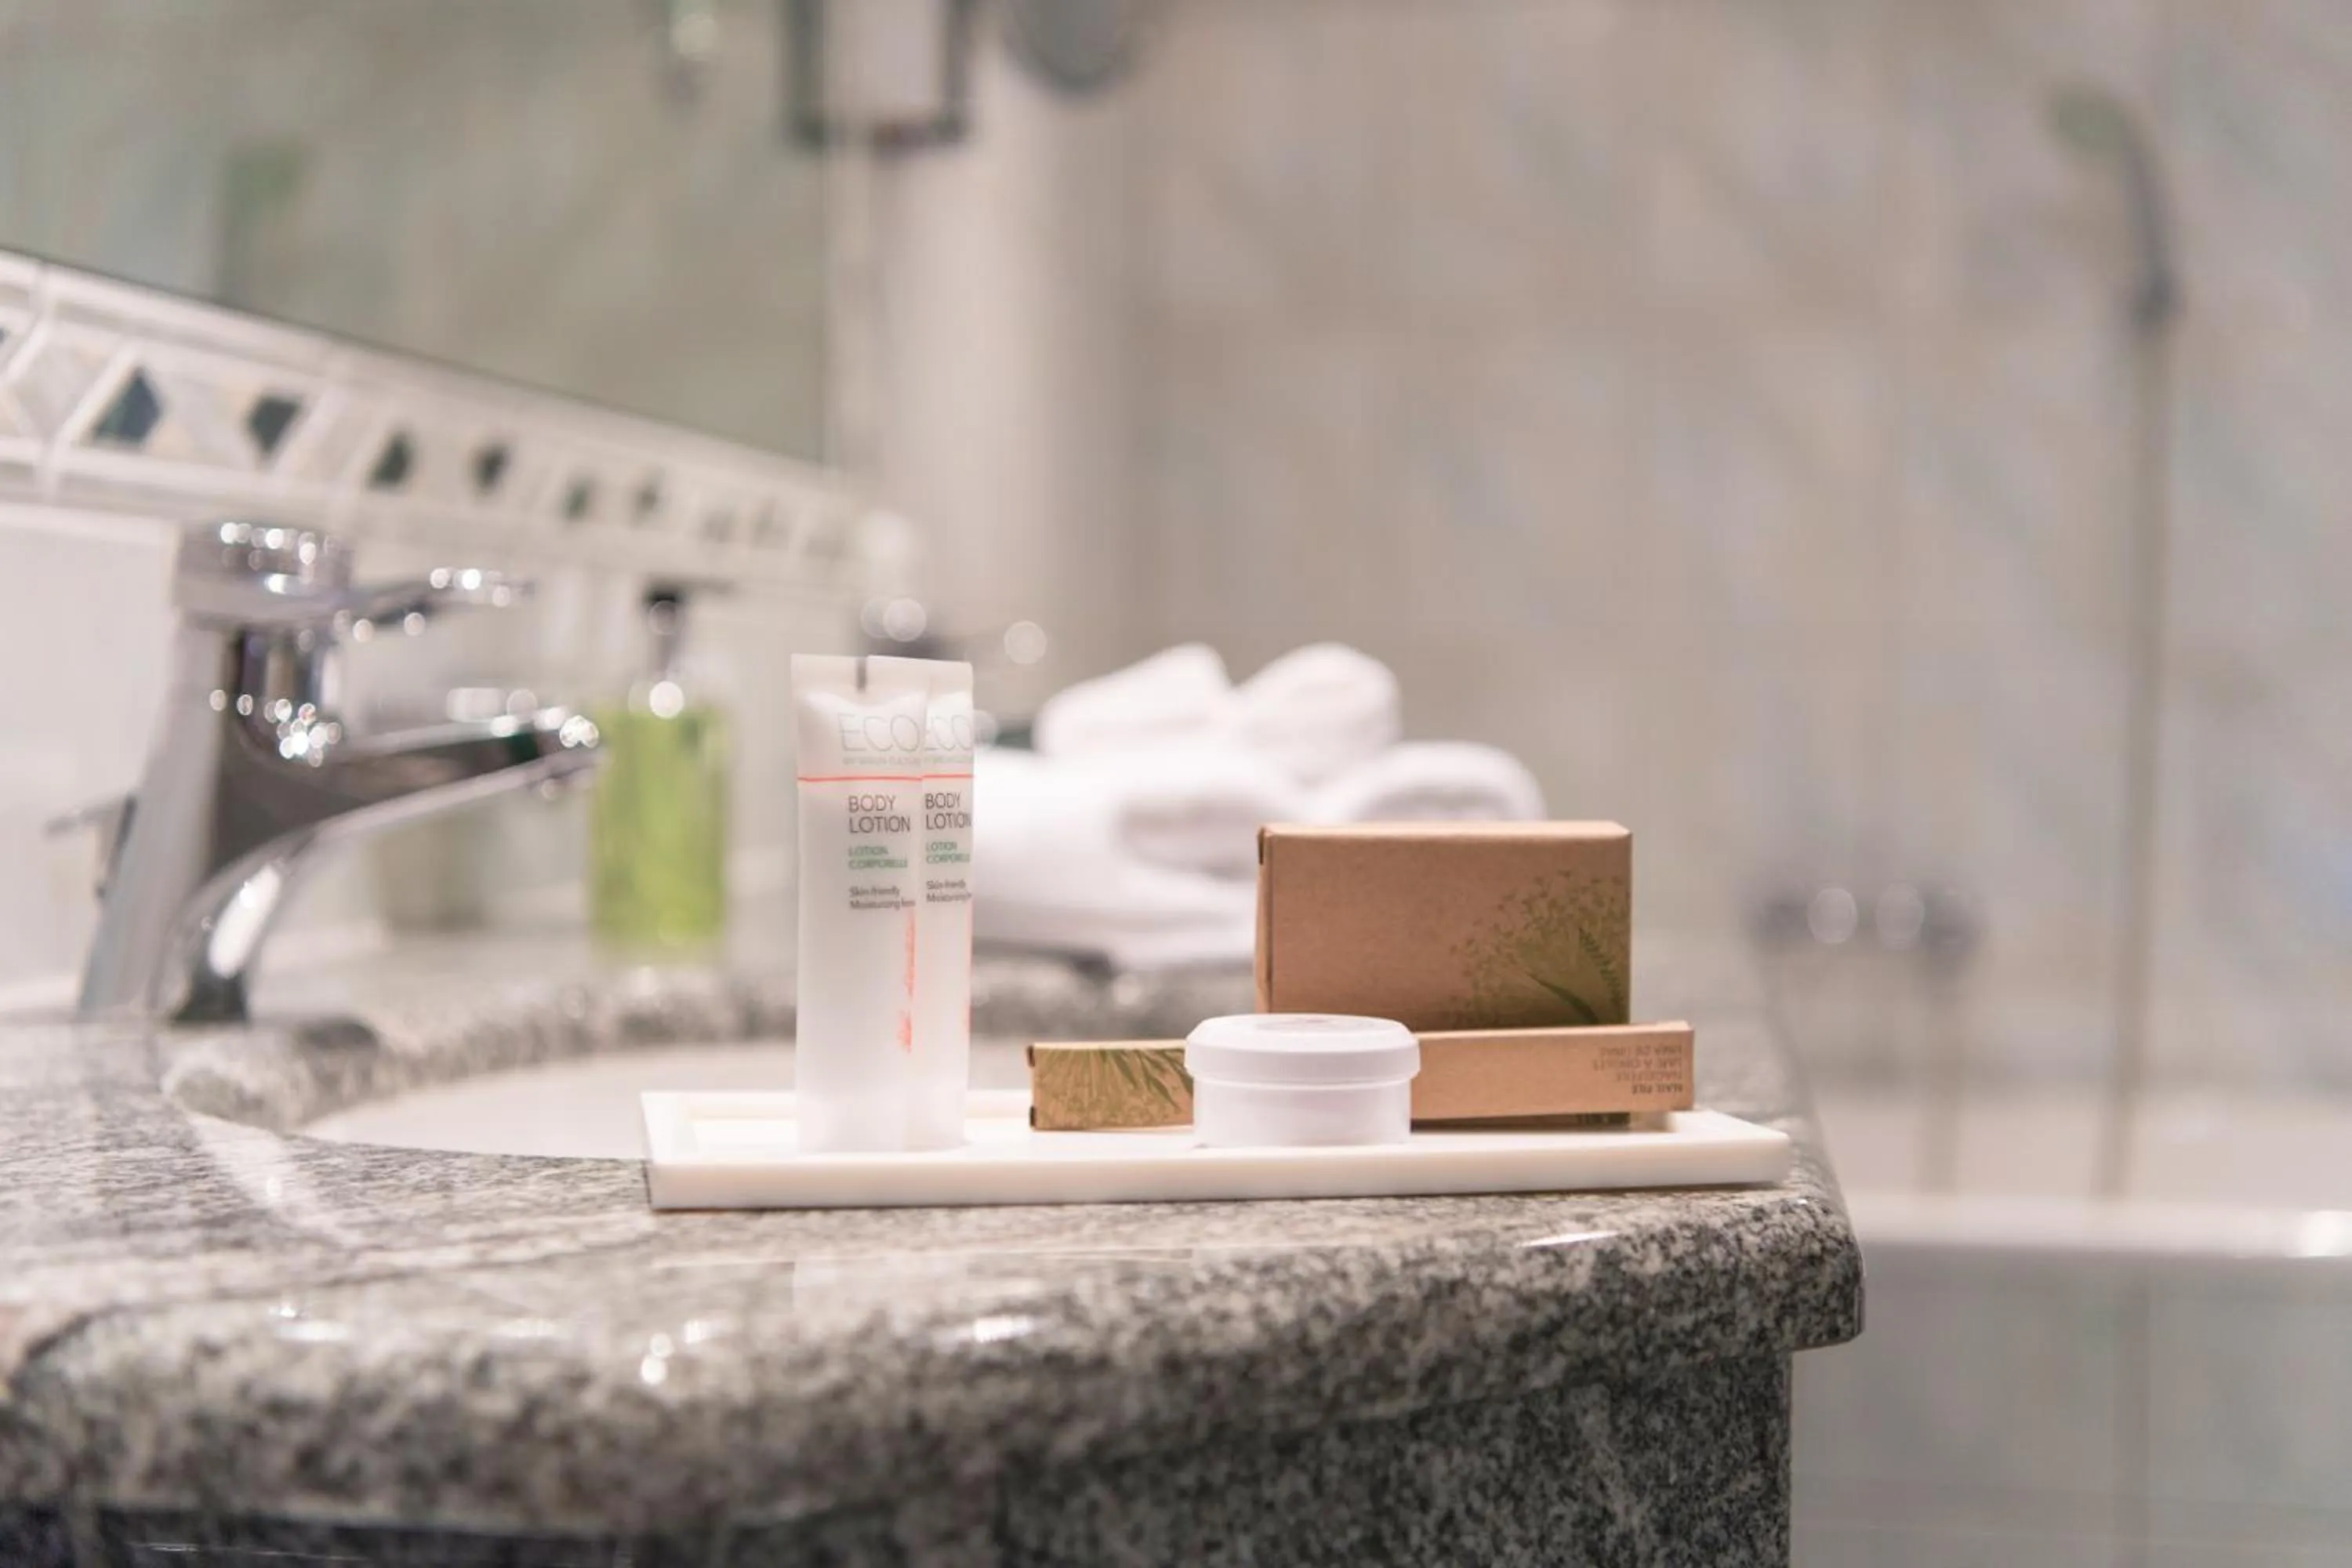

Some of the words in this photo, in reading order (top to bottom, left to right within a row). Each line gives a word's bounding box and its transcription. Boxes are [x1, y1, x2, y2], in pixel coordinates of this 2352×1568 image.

[838, 713, 920, 751] ECO
[848, 794, 897, 813] BODY
[925, 792, 961, 810] BODY
[849, 815, 911, 833] LOTION
